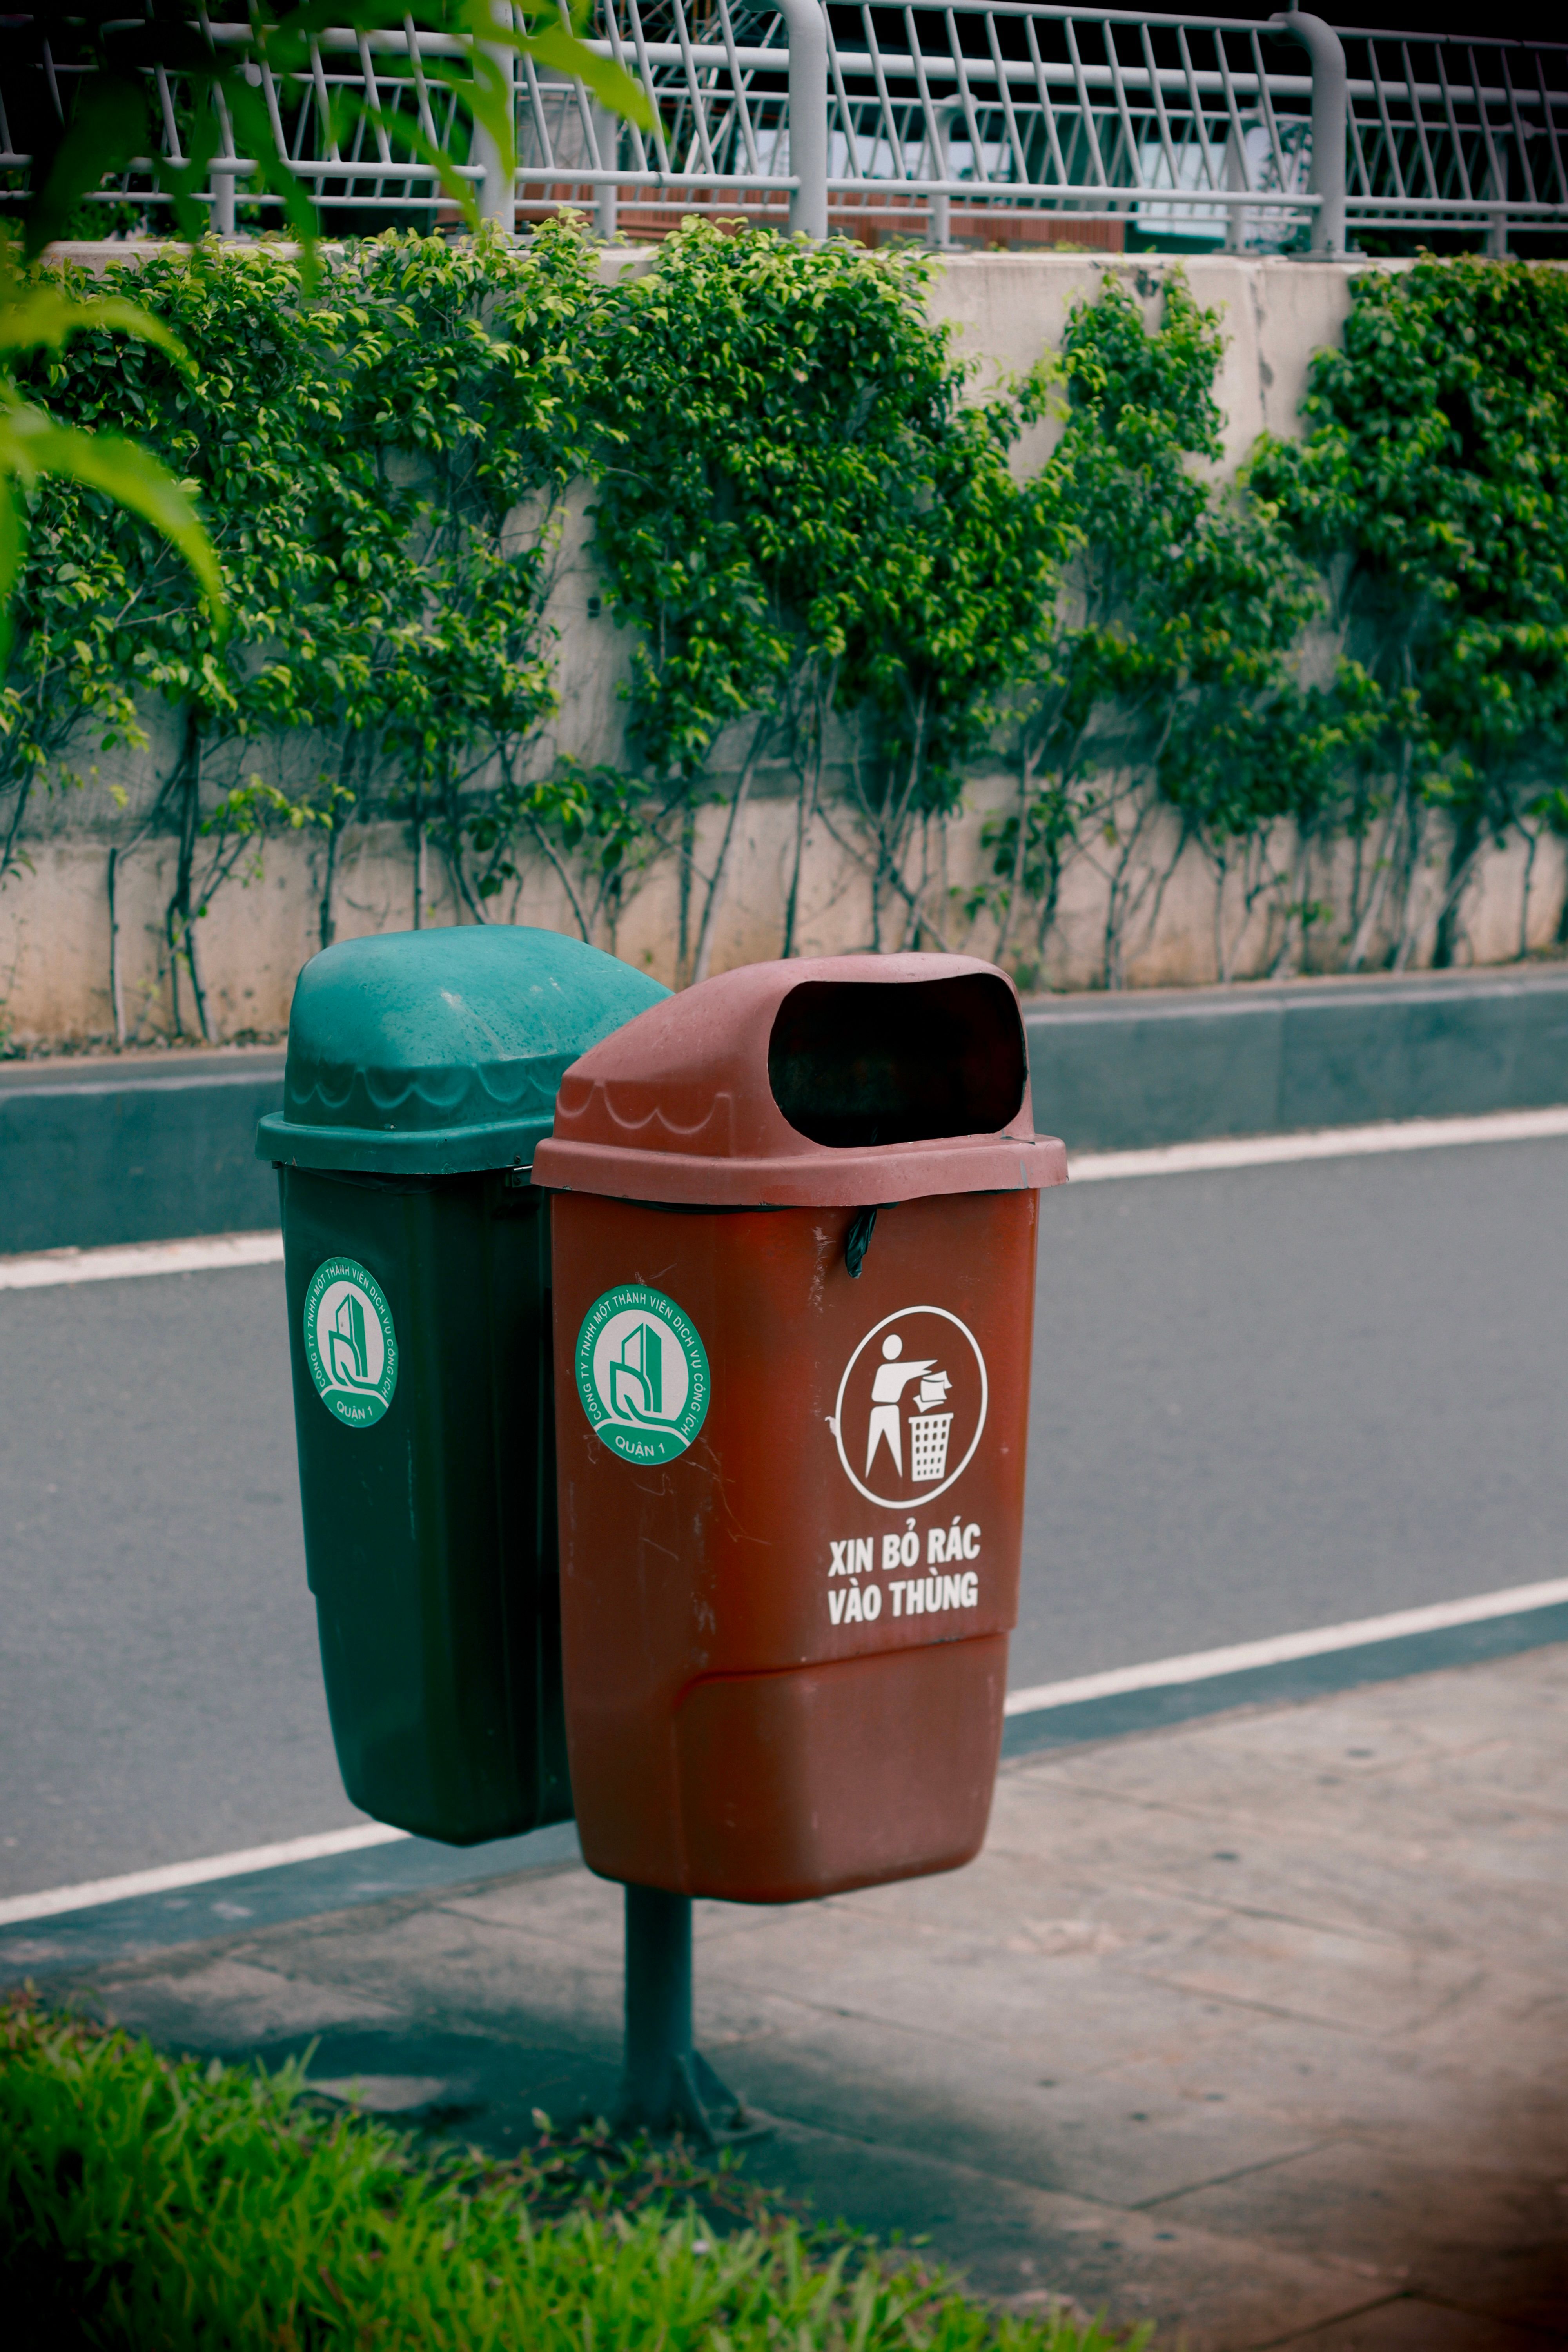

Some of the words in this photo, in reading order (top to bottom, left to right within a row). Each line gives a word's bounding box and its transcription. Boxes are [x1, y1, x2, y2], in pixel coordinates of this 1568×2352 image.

[326, 1262, 350, 1279] THÀNH
[352, 1268, 368, 1289] VIÊN
[612, 1290, 646, 1307] THÀNH
[650, 1296, 673, 1318] VIÊN
[308, 1296, 317, 1327] TNHH
[593, 1301, 612, 1324] MỘT
[309, 1334, 314, 1348] TY
[581, 1323, 597, 1357] TNHH
[673, 1316, 695, 1347] DỊCH
[310, 1352, 325, 1387] CÔNG
[581, 1363, 589, 1378] TY
[690, 1350, 701, 1368] VỤ
[583, 1383, 601, 1420] CÔNG
[691, 1373, 706, 1412] CÔNG
[337, 1401, 365, 1421] QUẬN
[368, 1406, 372, 1416] 1
[681, 1413, 697, 1436] ÍCH
[615, 1436, 654, 1458] QUẬN
[659, 1443, 665, 1453] 1
[828, 1537, 873, 1577] XIN
[882, 1517, 920, 1570] BỎ
[927, 1515, 981, 1564] RÁC
[828, 1577, 882, 1625] VÀO
[889, 1567, 978, 1617] THÙNG
